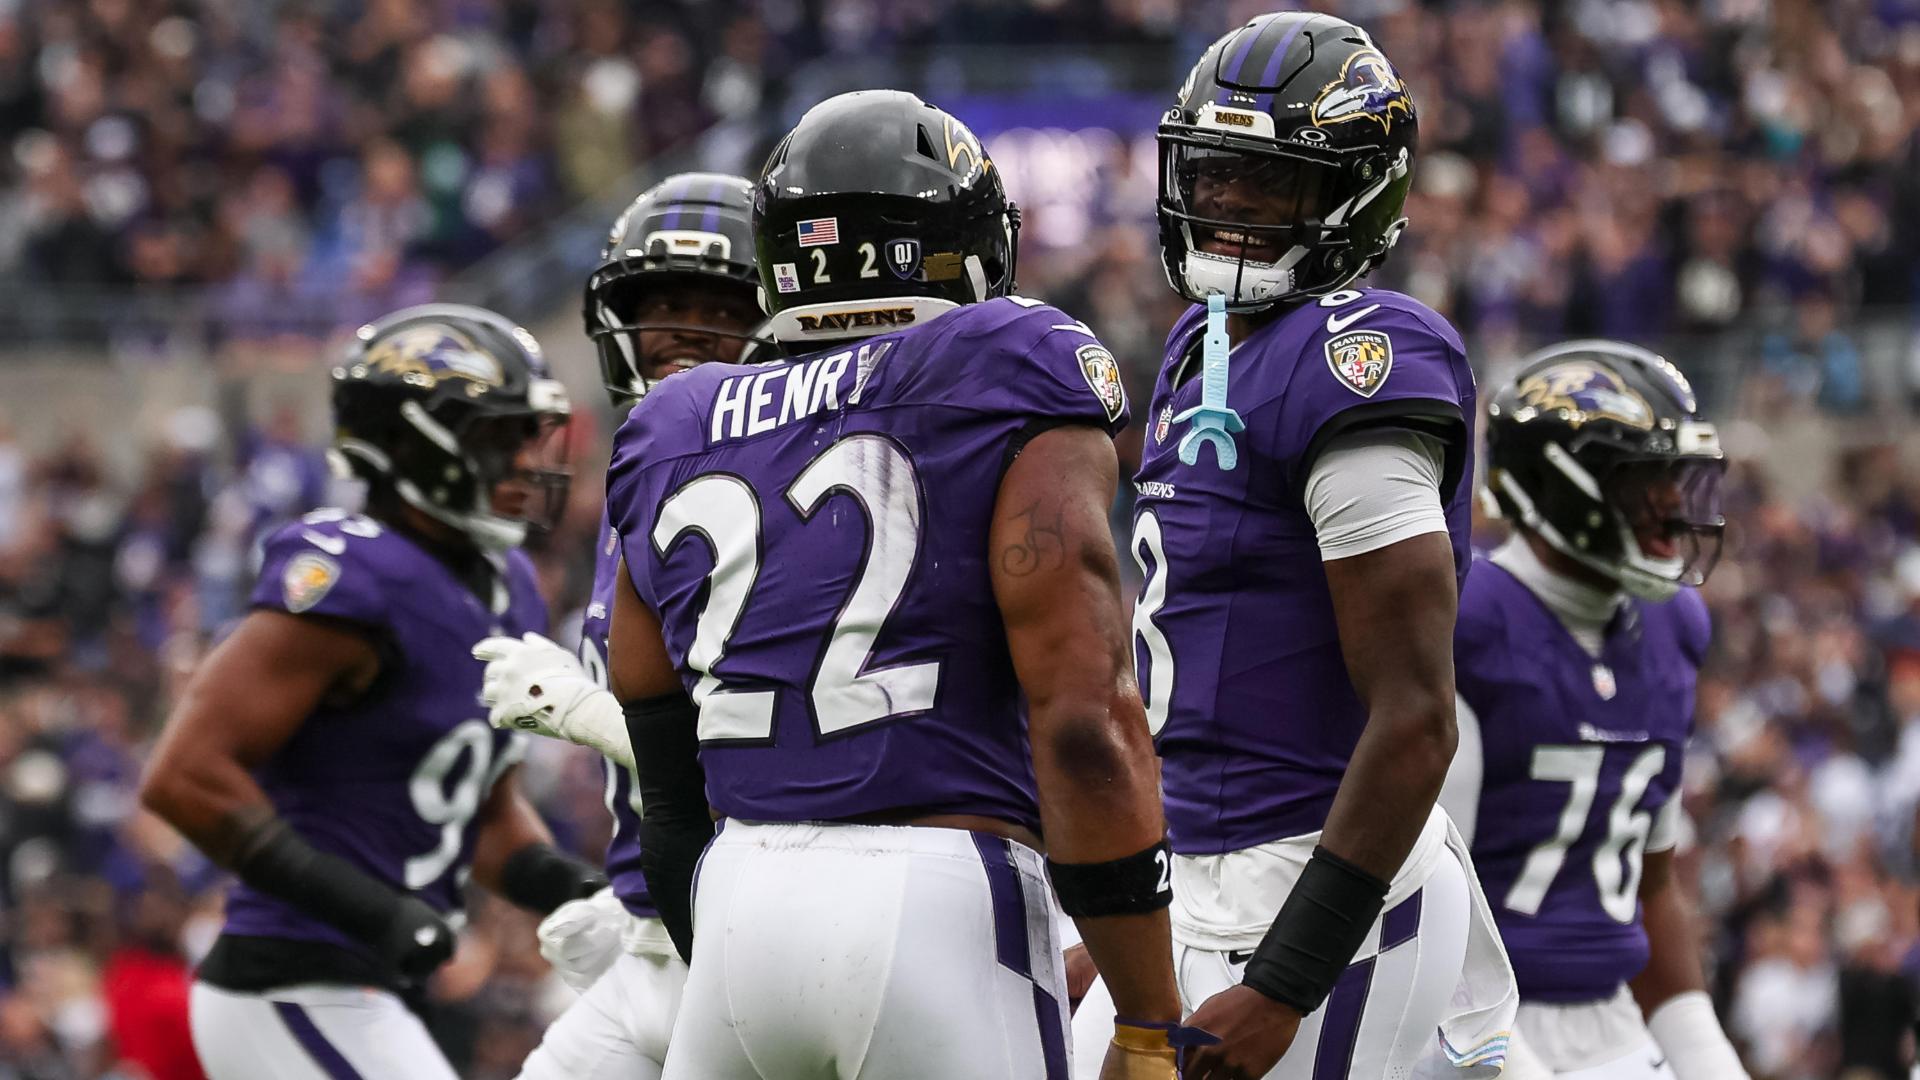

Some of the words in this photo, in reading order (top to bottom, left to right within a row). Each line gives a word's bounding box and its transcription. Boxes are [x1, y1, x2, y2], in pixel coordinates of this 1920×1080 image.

[1214, 111, 1255, 127] RAVENS
[796, 307, 915, 332] RAVENS
[1331, 335, 1383, 350] RAVENS
[711, 342, 892, 443] HENRY
[652, 435, 940, 741] 22
[1131, 511, 1174, 736] 8
[1504, 744, 1666, 925] 76
